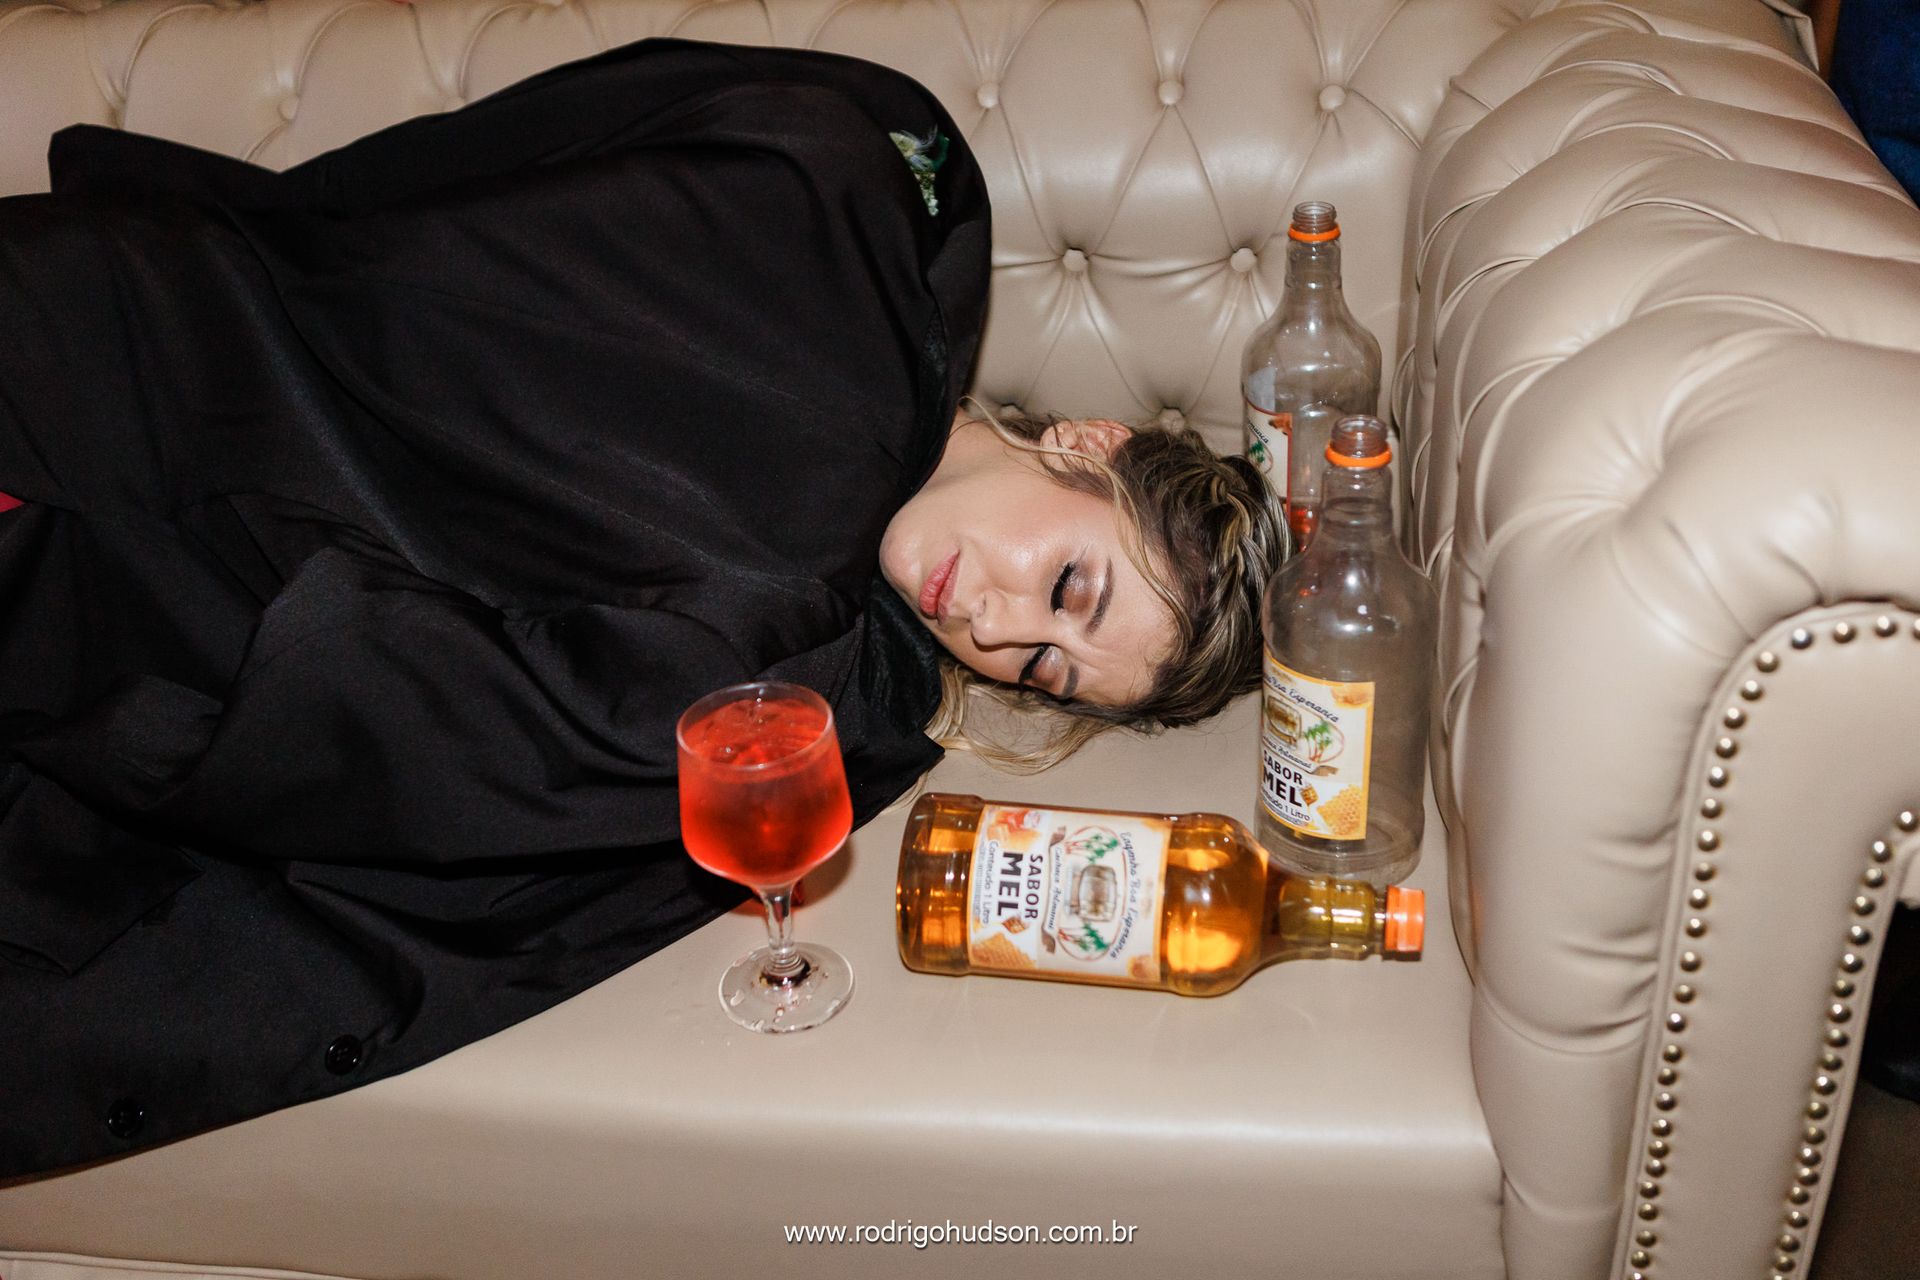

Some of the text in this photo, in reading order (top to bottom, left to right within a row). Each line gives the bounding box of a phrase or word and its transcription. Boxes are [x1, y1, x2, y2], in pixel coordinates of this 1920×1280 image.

[1263, 766, 1302, 808] MEL
[1291, 807, 1310, 822] Litro
[997, 852, 1024, 916] MEL
[1024, 853, 1043, 919] SABOR
